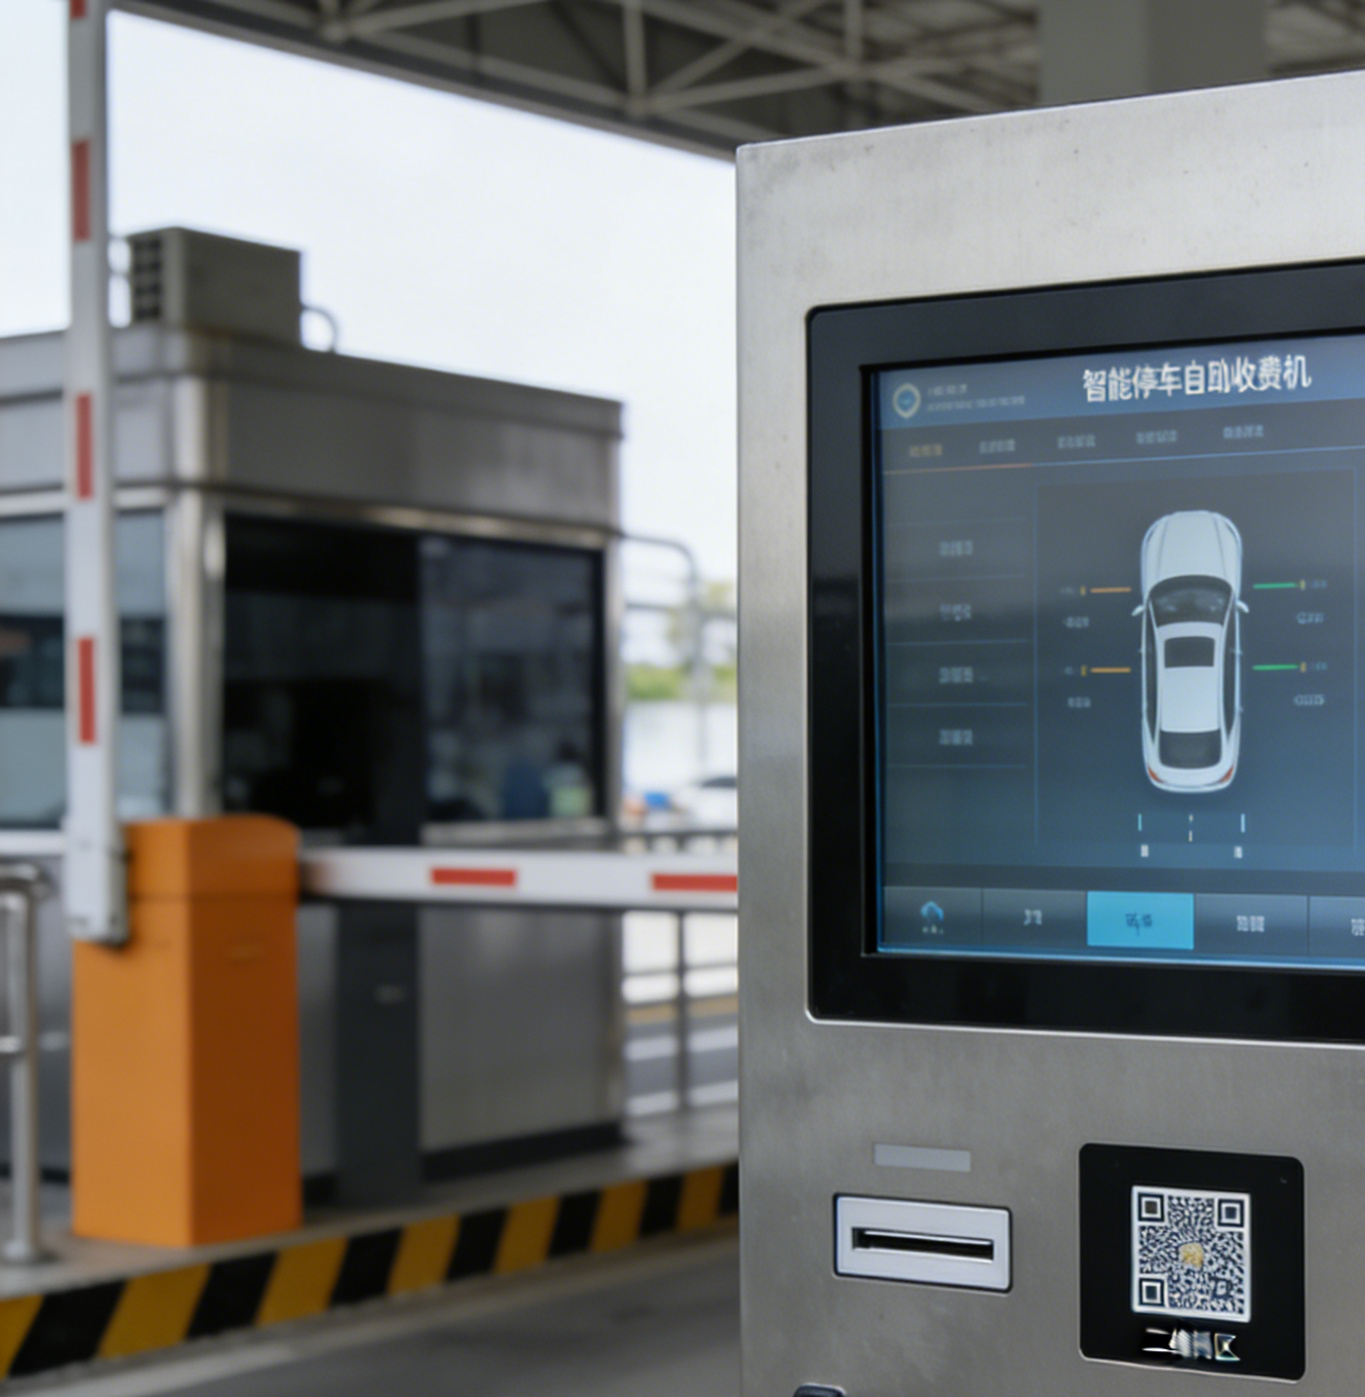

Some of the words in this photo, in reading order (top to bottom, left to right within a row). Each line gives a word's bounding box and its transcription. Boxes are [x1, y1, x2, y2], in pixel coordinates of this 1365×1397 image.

[1083, 354, 1312, 402] 智能停车自助收费机
